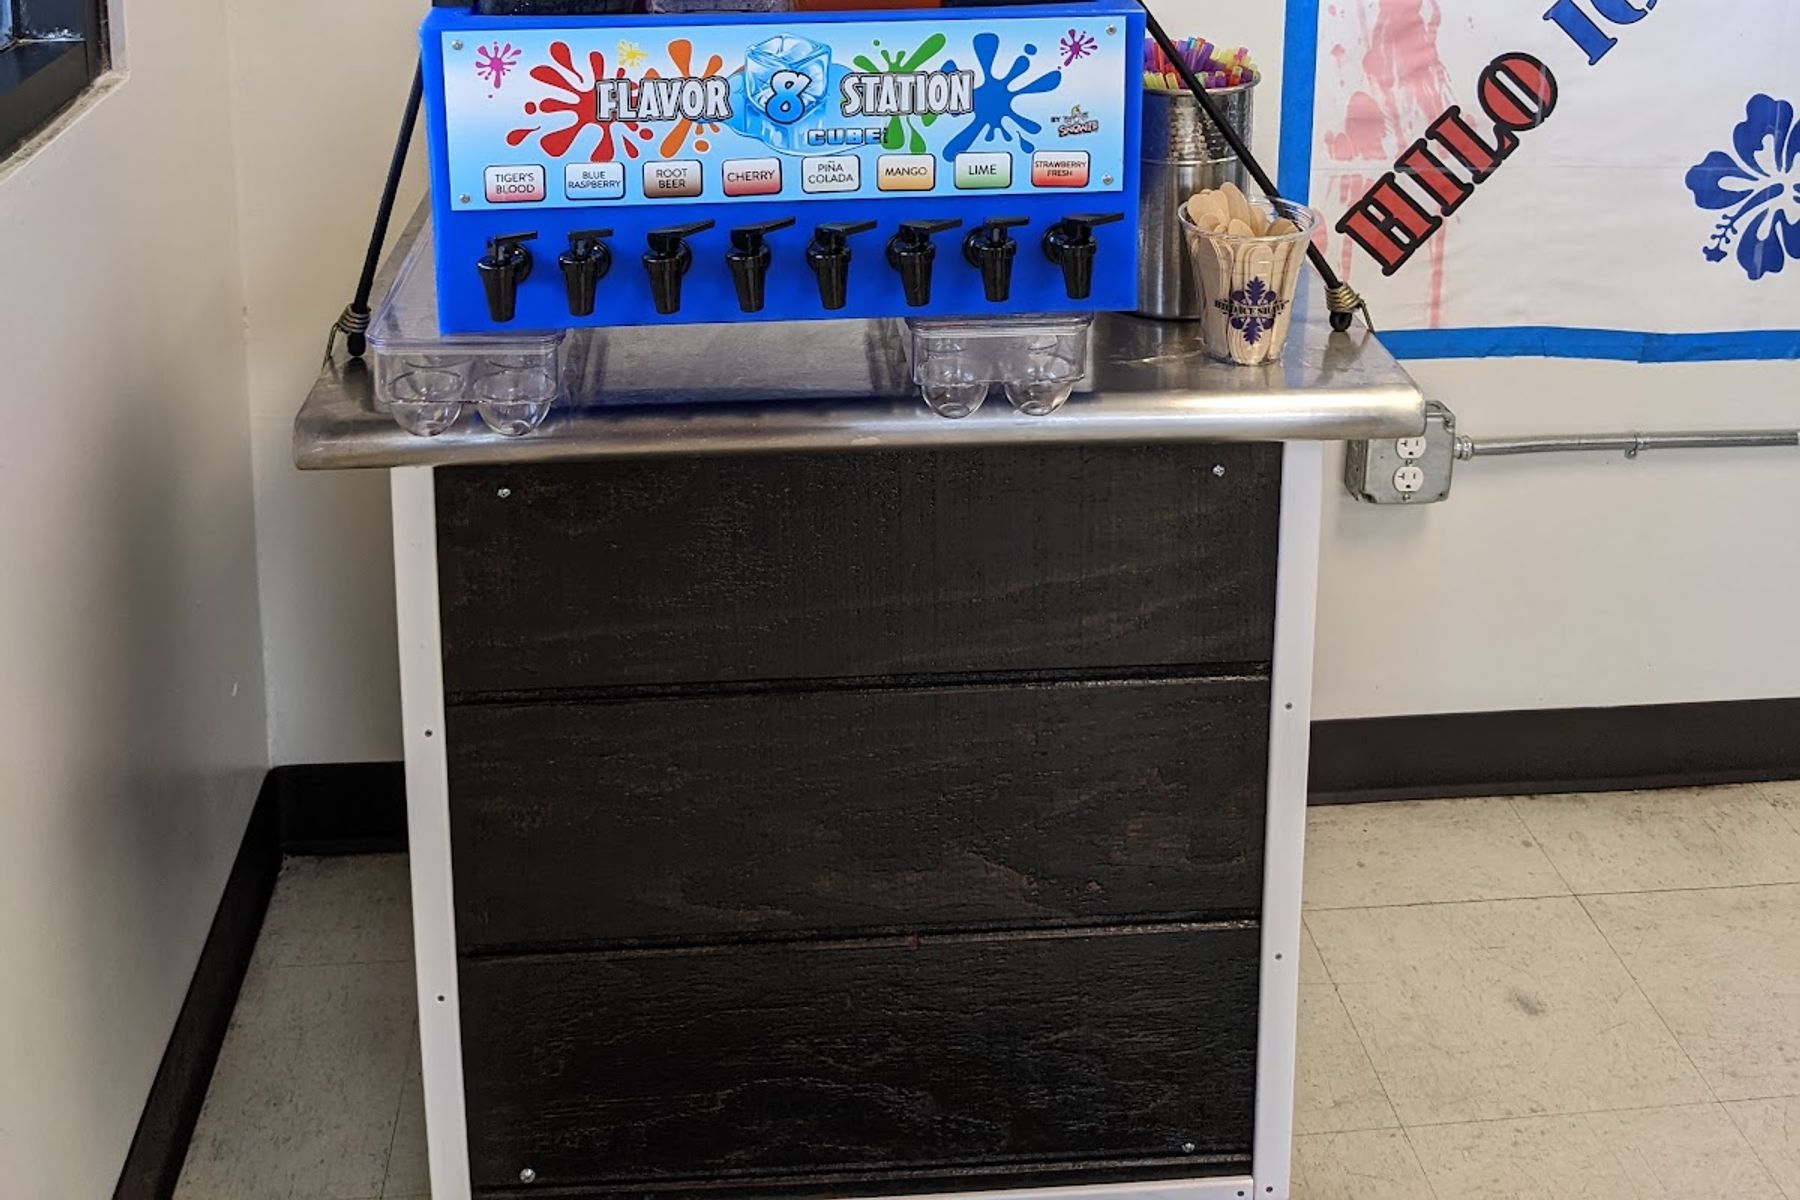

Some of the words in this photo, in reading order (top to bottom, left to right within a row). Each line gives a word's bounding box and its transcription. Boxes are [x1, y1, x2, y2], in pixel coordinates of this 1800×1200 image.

[596, 76, 732, 123] FLAVOR
[765, 69, 812, 124] 8
[840, 70, 976, 118] STATION
[807, 126, 882, 147] CUBE
[817, 160, 844, 172] PIÑA
[1034, 160, 1087, 169] STRAWBERRY
[1336, 51, 1558, 275] HILO
[582, 171, 606, 180] BLUE
[656, 168, 688, 179] ROOT
[885, 166, 928, 177] MANGO
[968, 164, 997, 177] LIME
[1047, 169, 1073, 177] FRESH
[495, 173, 535, 183] TIGER'S
[727, 170, 775, 183] CHERRY
[808, 173, 854, 185] COLADA
[496, 184, 535, 195] BLOOD
[568, 179, 622, 189] RASPBERRY
[658, 179, 686, 189] BEER
